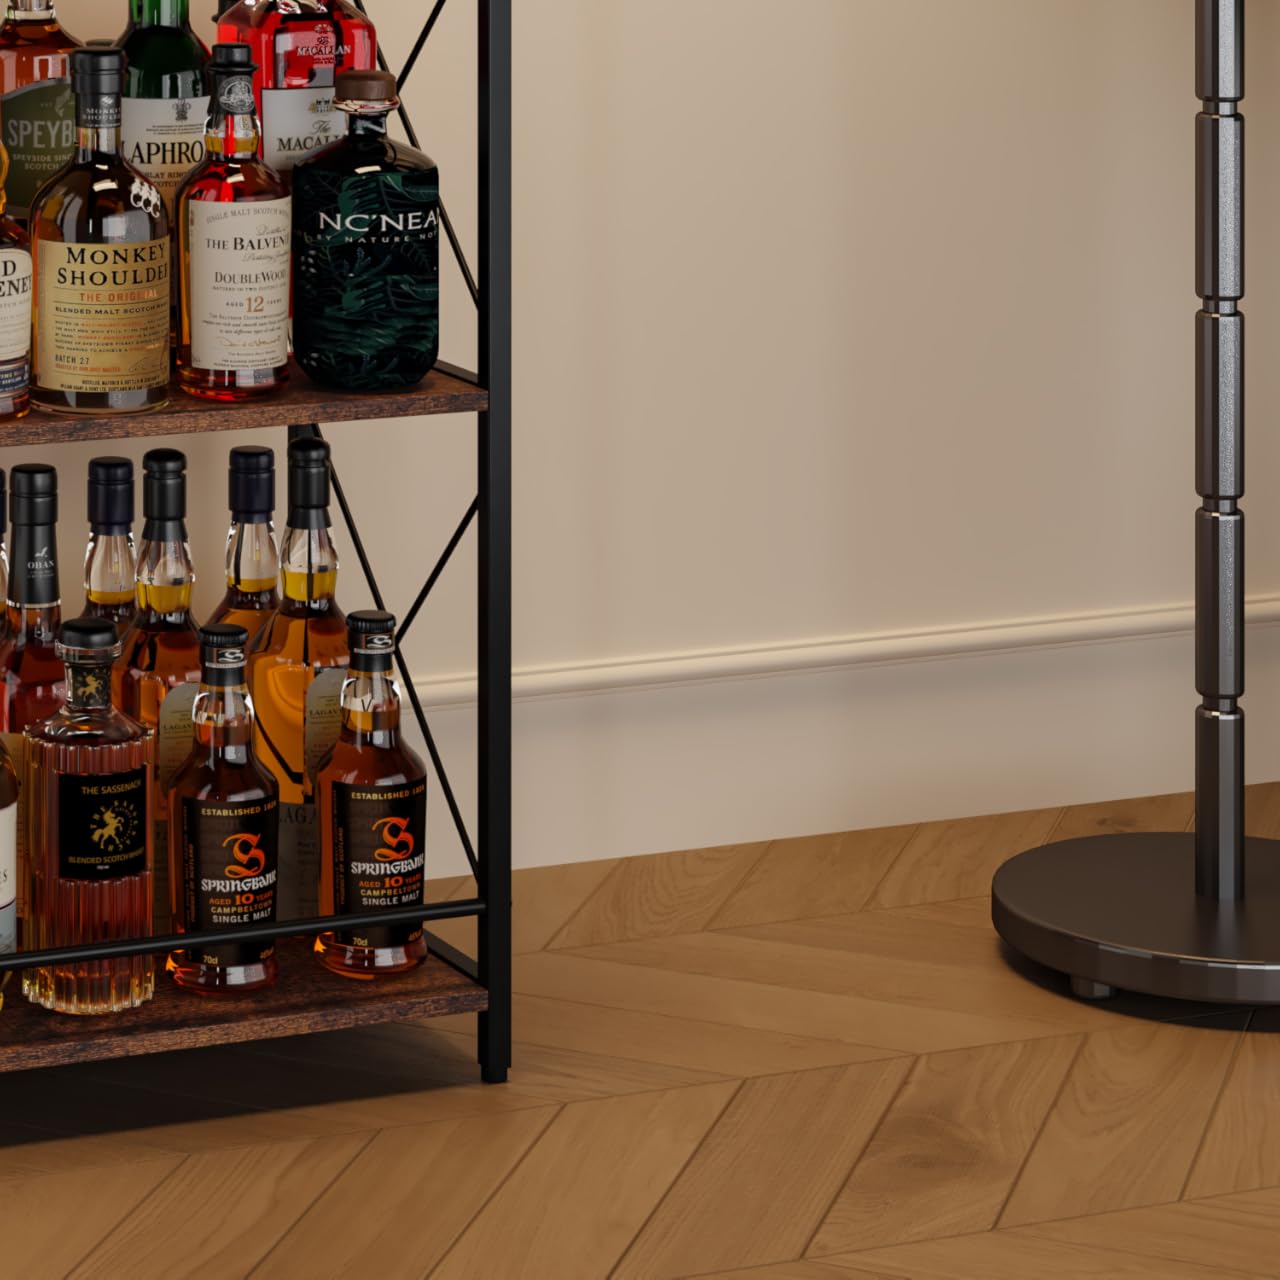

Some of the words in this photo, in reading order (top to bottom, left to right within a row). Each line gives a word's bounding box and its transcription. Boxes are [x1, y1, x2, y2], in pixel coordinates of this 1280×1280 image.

[7, 119, 73, 149] SPEYB
[206, 238, 229, 251] THE
[345, 236, 411, 244] NATURE
[67, 242, 166, 265] MONKEY
[80, 293, 102, 302] THE
[55, 306, 92, 315] BLENDED
[246, 296, 265, 313] 12
[55, 355, 77, 365] BATCH
[81, 785, 99, 795] THE
[351, 791, 410, 801] ESTABLISHED
[202, 806, 262, 817] ESTABLISHED
[359, 880, 381, 888] AGED
[384, 876, 404, 889] 10
[209, 898, 231, 906] AGED
[235, 893, 255, 905] 10
[362, 896, 399, 906] SINGLE
[402, 890, 420, 904] MALT
[212, 914, 249, 923] SINGLE
[253, 907, 272, 921] MALT
